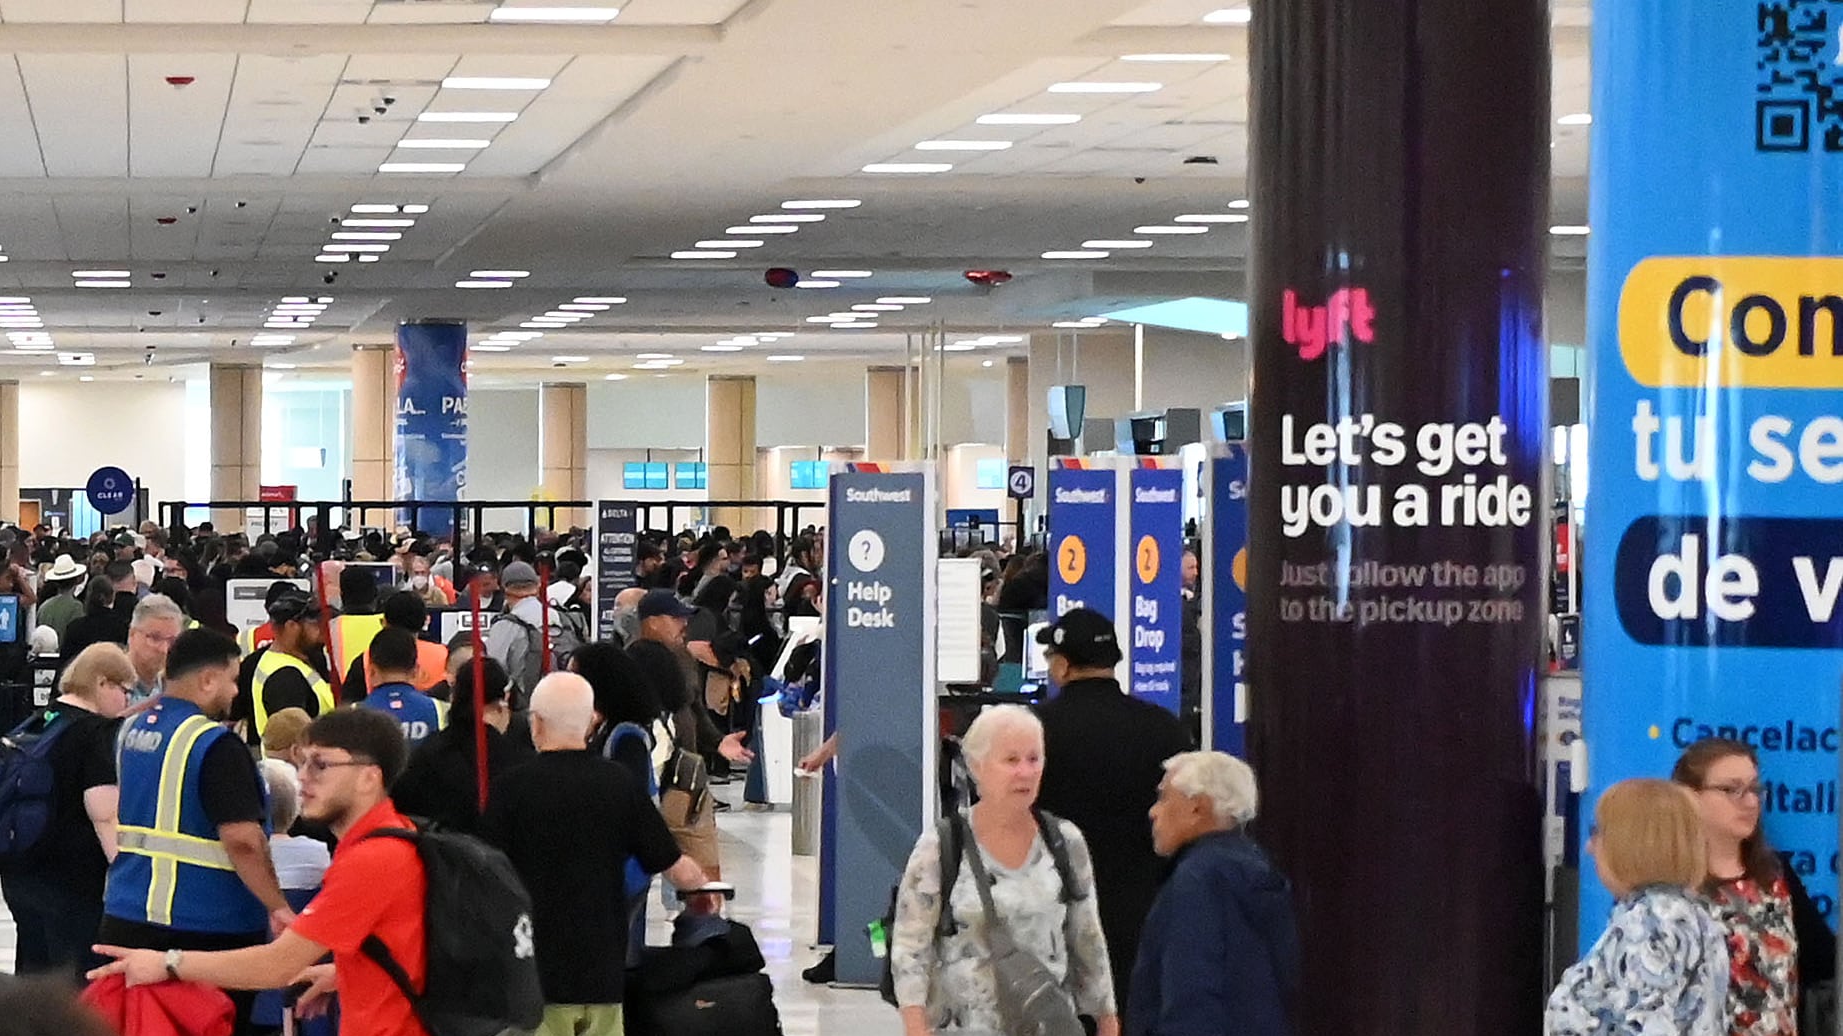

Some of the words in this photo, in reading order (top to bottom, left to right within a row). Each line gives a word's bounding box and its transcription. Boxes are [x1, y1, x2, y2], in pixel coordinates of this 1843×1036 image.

[1281, 287, 1376, 360] lyft
[1668, 275, 1843, 357] Con
[1415, 415, 1507, 475] get
[1632, 400, 1715, 481] tu
[1746, 415, 1843, 484] se
[846, 487, 910, 502] Southwest
[1014, 472, 1027, 491] 4
[1055, 487, 1106, 503] Southwest
[1135, 487, 1176, 503] Southwest
[1280, 483, 1379, 535] you
[1392, 483, 1429, 527] a
[1440, 474, 1531, 527] ride
[1068, 548, 1076, 571] 2
[1144, 548, 1151, 571] 2
[1280, 560, 1327, 587] Just
[1334, 560, 1427, 587] ollow
[1431, 560, 1478, 587] the
[1483, 564, 1525, 591] app
[1648, 533, 1759, 622] de
[1792, 556, 1843, 623] v
[847, 582, 892, 606] Help
[847, 608, 894, 629] Desk
[1135, 595, 1157, 624] Bag
[1280, 597, 1304, 622] to
[1309, 596, 1354, 622] the
[1360, 595, 1463, 627] pickup
[1467, 600, 1524, 622] zone
[1135, 626, 1164, 653] Drop
[1672, 718, 1839, 752] Cancelac
